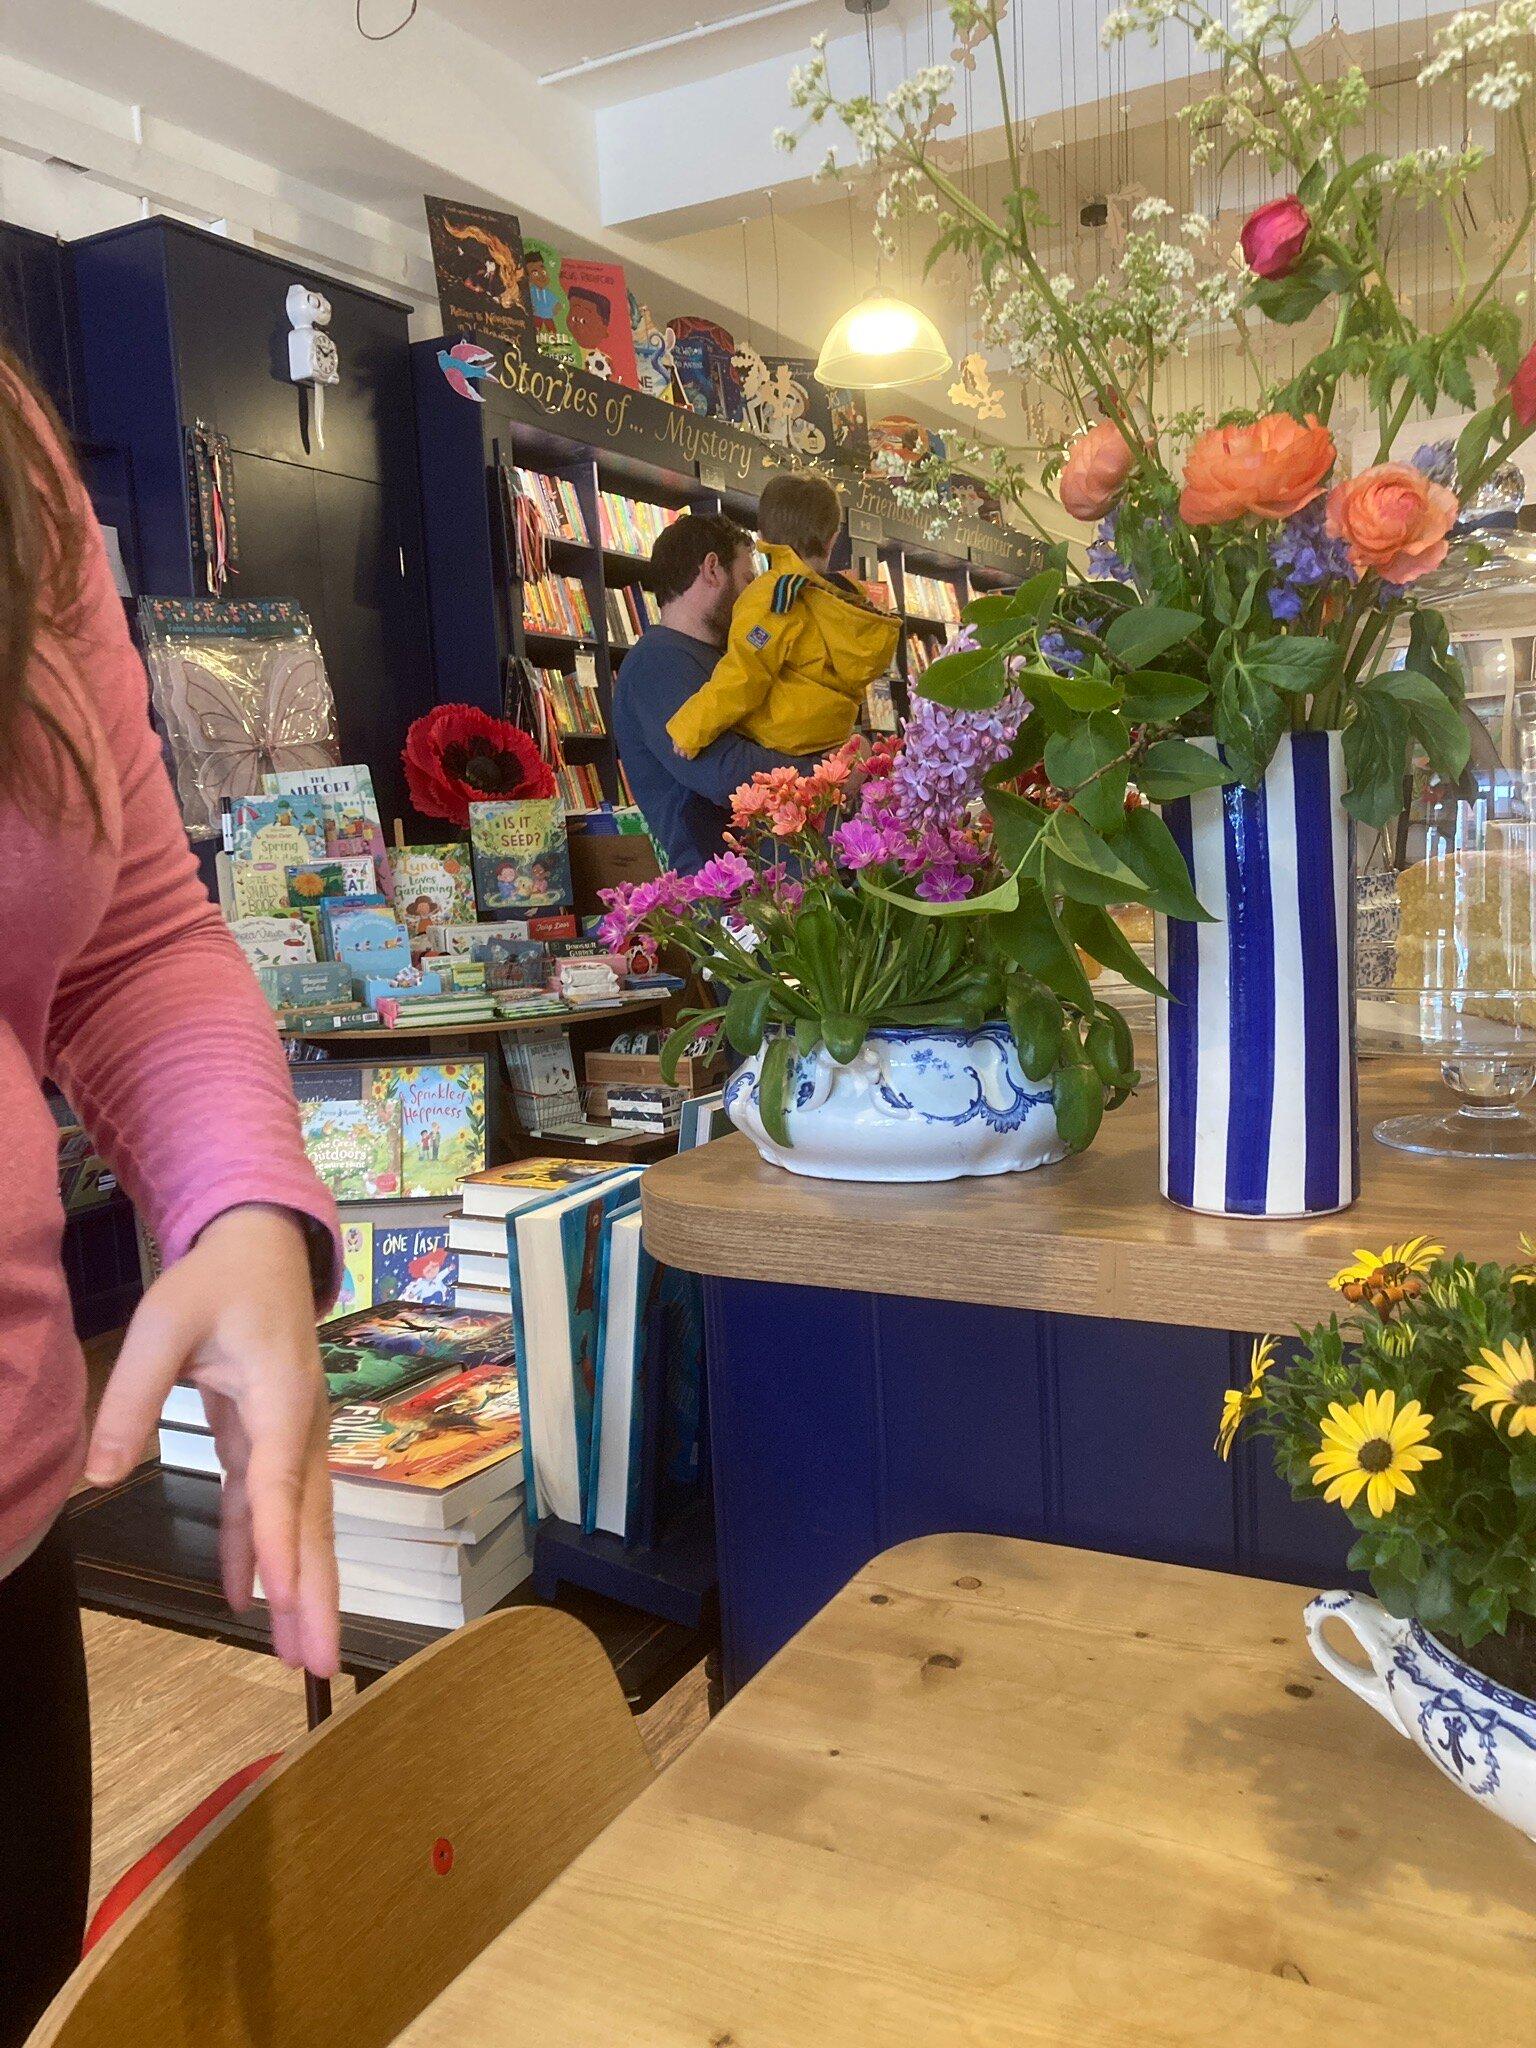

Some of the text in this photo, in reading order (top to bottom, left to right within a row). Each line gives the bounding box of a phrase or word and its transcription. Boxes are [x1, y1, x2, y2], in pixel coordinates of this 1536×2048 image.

[499, 350, 598, 417] Stories
[655, 411, 752, 479] Mystery
[310, 776, 325, 784] THE
[290, 781, 351, 796] AIRPORT
[503, 816, 531, 829] IS IT
[501, 832, 541, 847] SEED?
[261, 841, 298, 853] Spring
[402, 856, 440, 875] Luna
[408, 875, 436, 886] Loves
[393, 884, 453, 898] Gardening
[248, 898, 277, 912] BOOK
[410, 1083, 455, 1106] Sprinkle
[457, 1091, 466, 1105] of
[403, 1106, 462, 1126] Happiness
[308, 1147, 366, 1161] Outdoors
[383, 1233, 408, 1255] ONE
[413, 1232, 440, 1255] LAST
